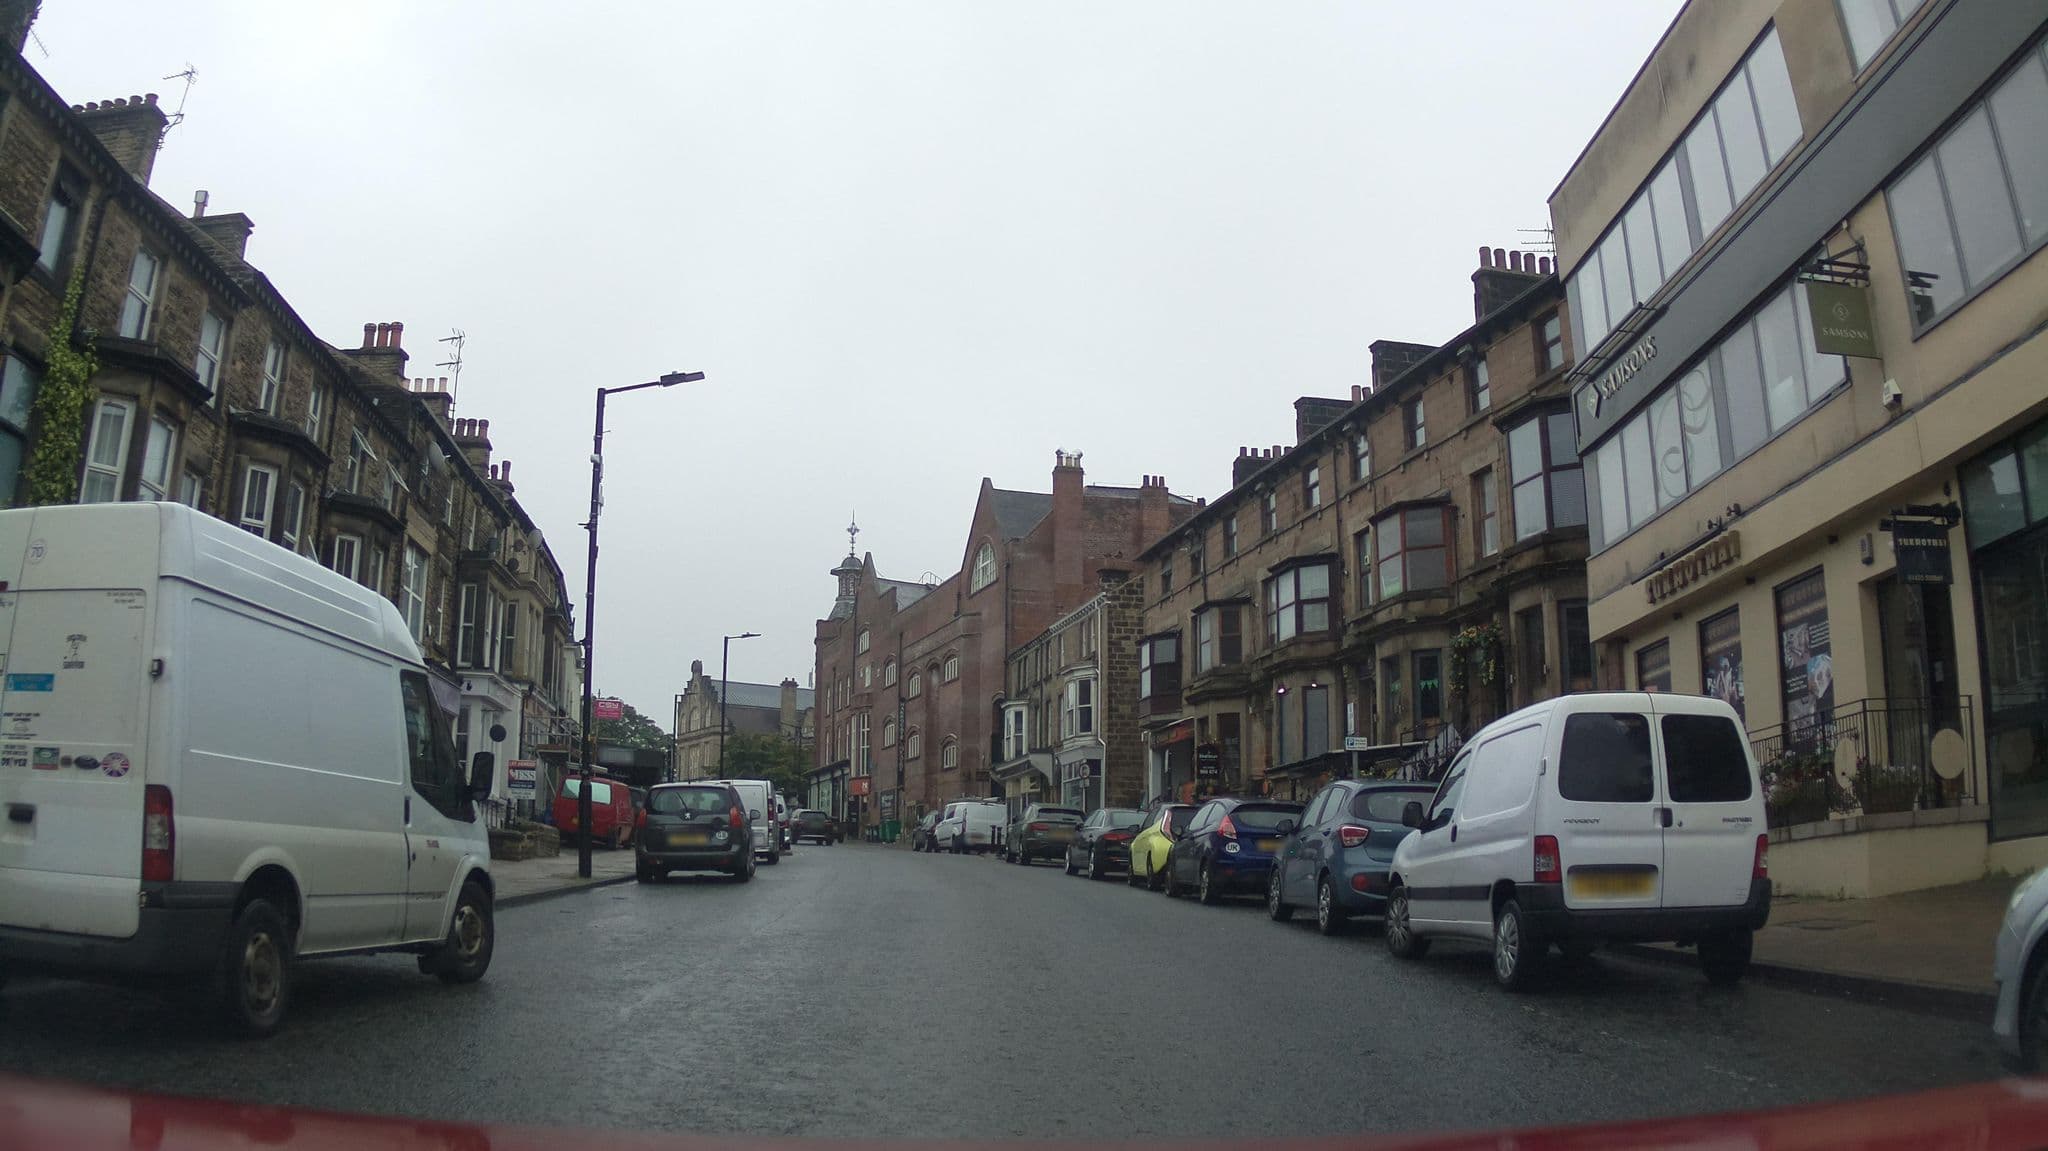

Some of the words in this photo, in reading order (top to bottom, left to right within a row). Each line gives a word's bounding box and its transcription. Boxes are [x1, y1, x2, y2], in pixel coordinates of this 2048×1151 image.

[1822, 326, 1870, 341] SAMSONS
[1601, 335, 1658, 401] SAMSONS
[1227, 844, 1238, 852] UK
